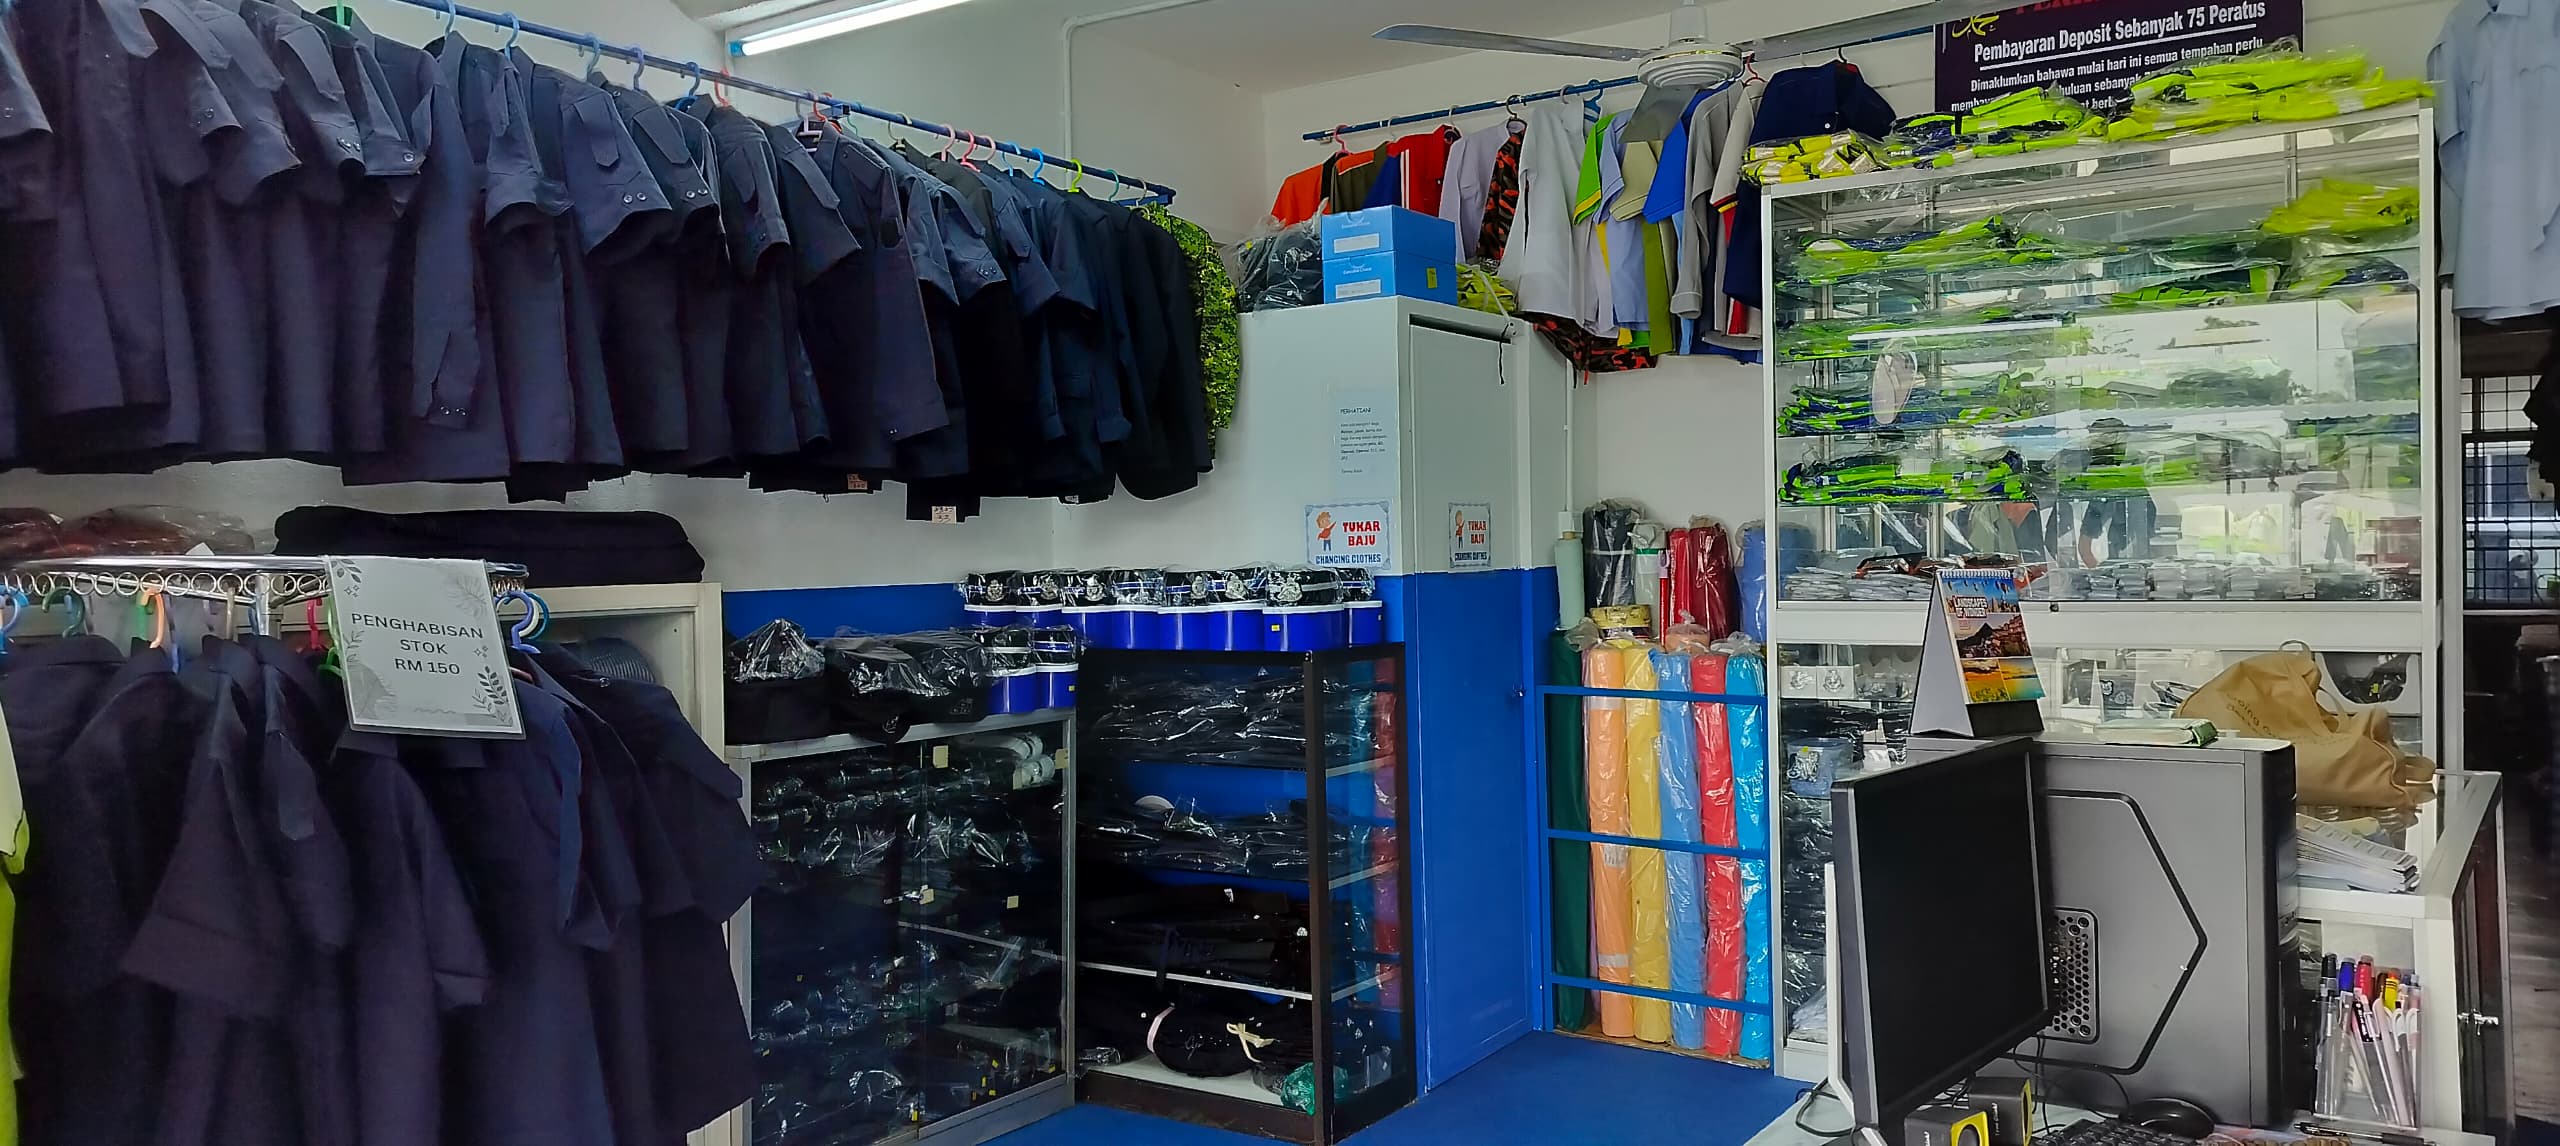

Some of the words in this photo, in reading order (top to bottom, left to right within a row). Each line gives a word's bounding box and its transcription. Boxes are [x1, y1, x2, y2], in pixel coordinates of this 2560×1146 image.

[1974, 36, 2055, 62] Pembayaran
[2059, 22, 2112, 50] Deposit
[2115, 12, 2183, 39] Sebanyak
[2187, 7, 2205, 28] 75
[2209, 1, 2265, 25] Peratus
[1970, 73, 2034, 92] Dimaklumkan
[2036, 67, 2075, 82] bahawa
[2077, 60, 2104, 75] mulai
[2107, 56, 2127, 71] hari
[2129, 54, 2141, 68] ini
[2144, 51, 2178, 66] semua
[2181, 42, 2233, 59] tempahan
[2236, 36, 2263, 55] perlu
[1342, 520, 1381, 533] TUKAR
[1348, 535, 1376, 546] BAJU
[1316, 554, 1350, 564] CHANGING
[1351, 553, 1381, 564] CLOTHES
[1952, 595, 1988, 608] LANDSCAPES
[351, 613, 484, 639] PENGHABISAN
[399, 638, 449, 655] STOK
[394, 658, 424, 673] RM
[428, 662, 461, 675] 150
